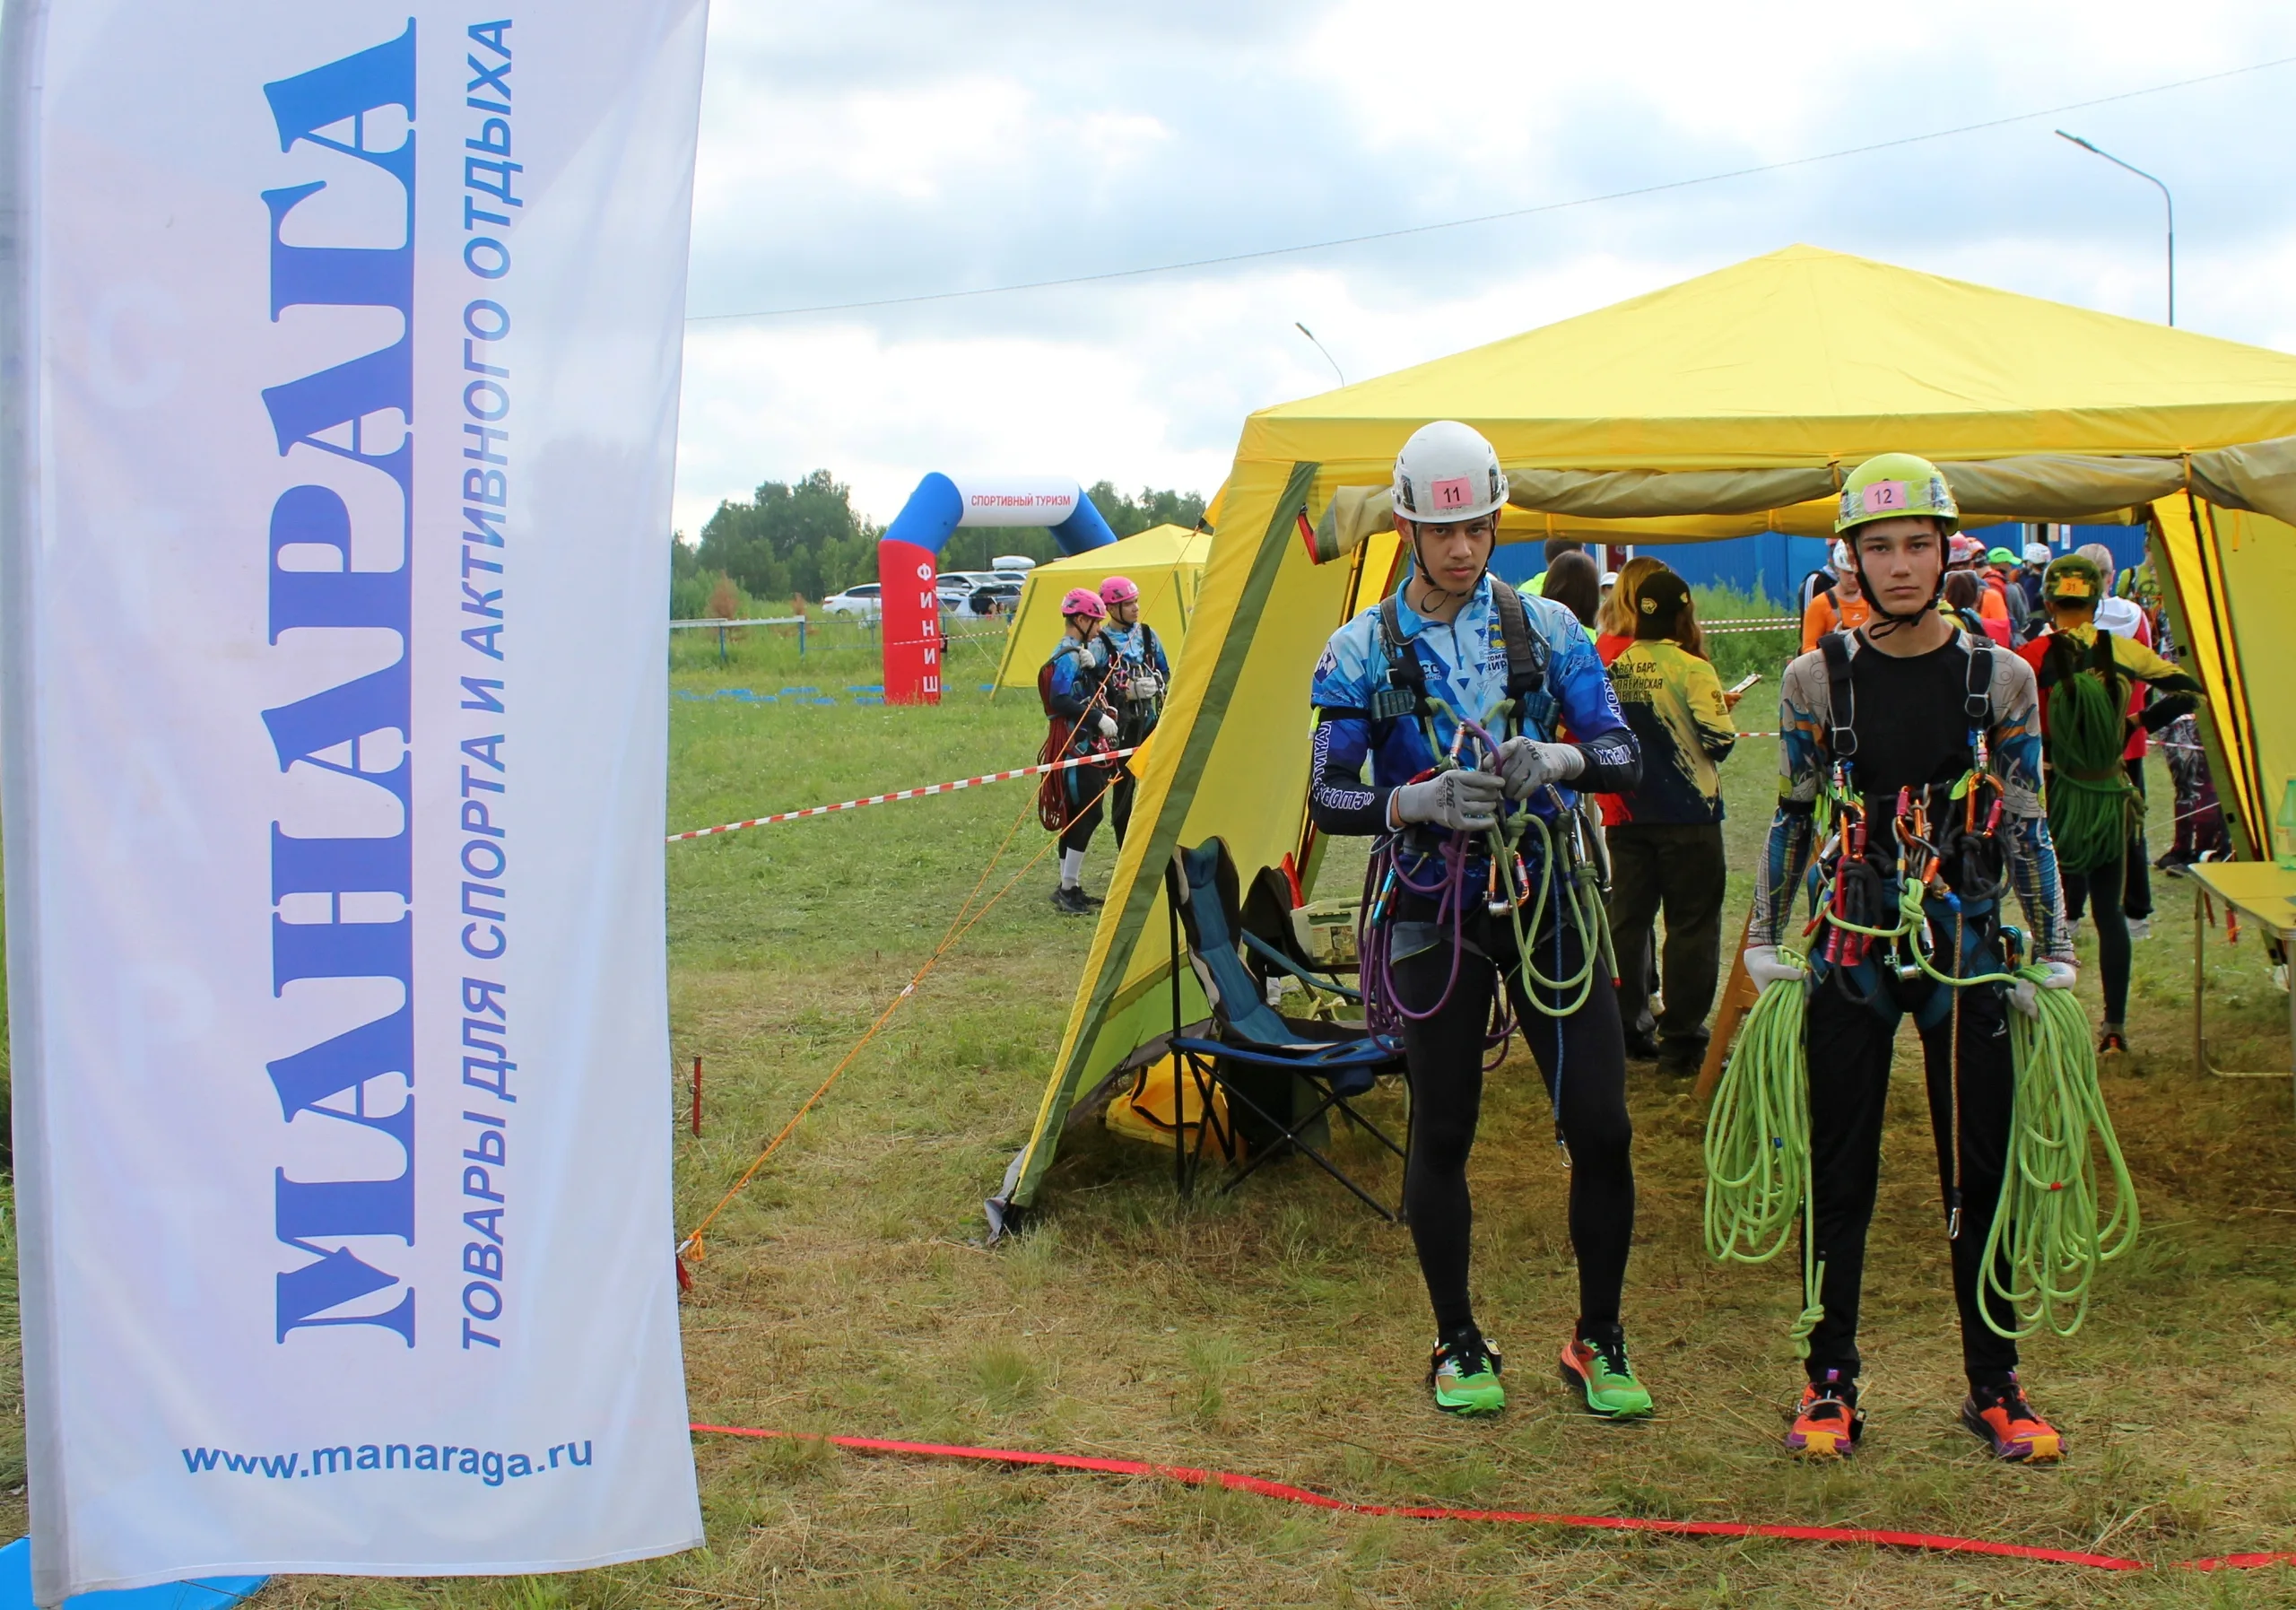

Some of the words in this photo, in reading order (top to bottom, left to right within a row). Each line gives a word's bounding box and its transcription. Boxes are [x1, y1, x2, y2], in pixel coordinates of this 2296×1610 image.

[461, 16, 524, 279] ОТДЫХА
[459, 298, 510, 661] АКТИВНОГО
[971, 492, 1033, 507] СПОРТИВНЫЙ
[1036, 495, 1071, 507] ТУРИЗМ
[1444, 486, 1460, 503] 11
[1874, 488, 1892, 505] 12
[261, 16, 417, 1349] МАНАРАГА
[917, 563, 938, 692] ФИНИШ
[1636, 662, 1657, 673] БАРС
[459, 676, 505, 714] И
[460, 734, 507, 960] СПОРТА
[461, 978, 517, 1105] ДЛЯ
[461, 1111, 508, 1352] ТОВАРЫ
[181, 1440, 594, 1487] www.manaraga.ru
